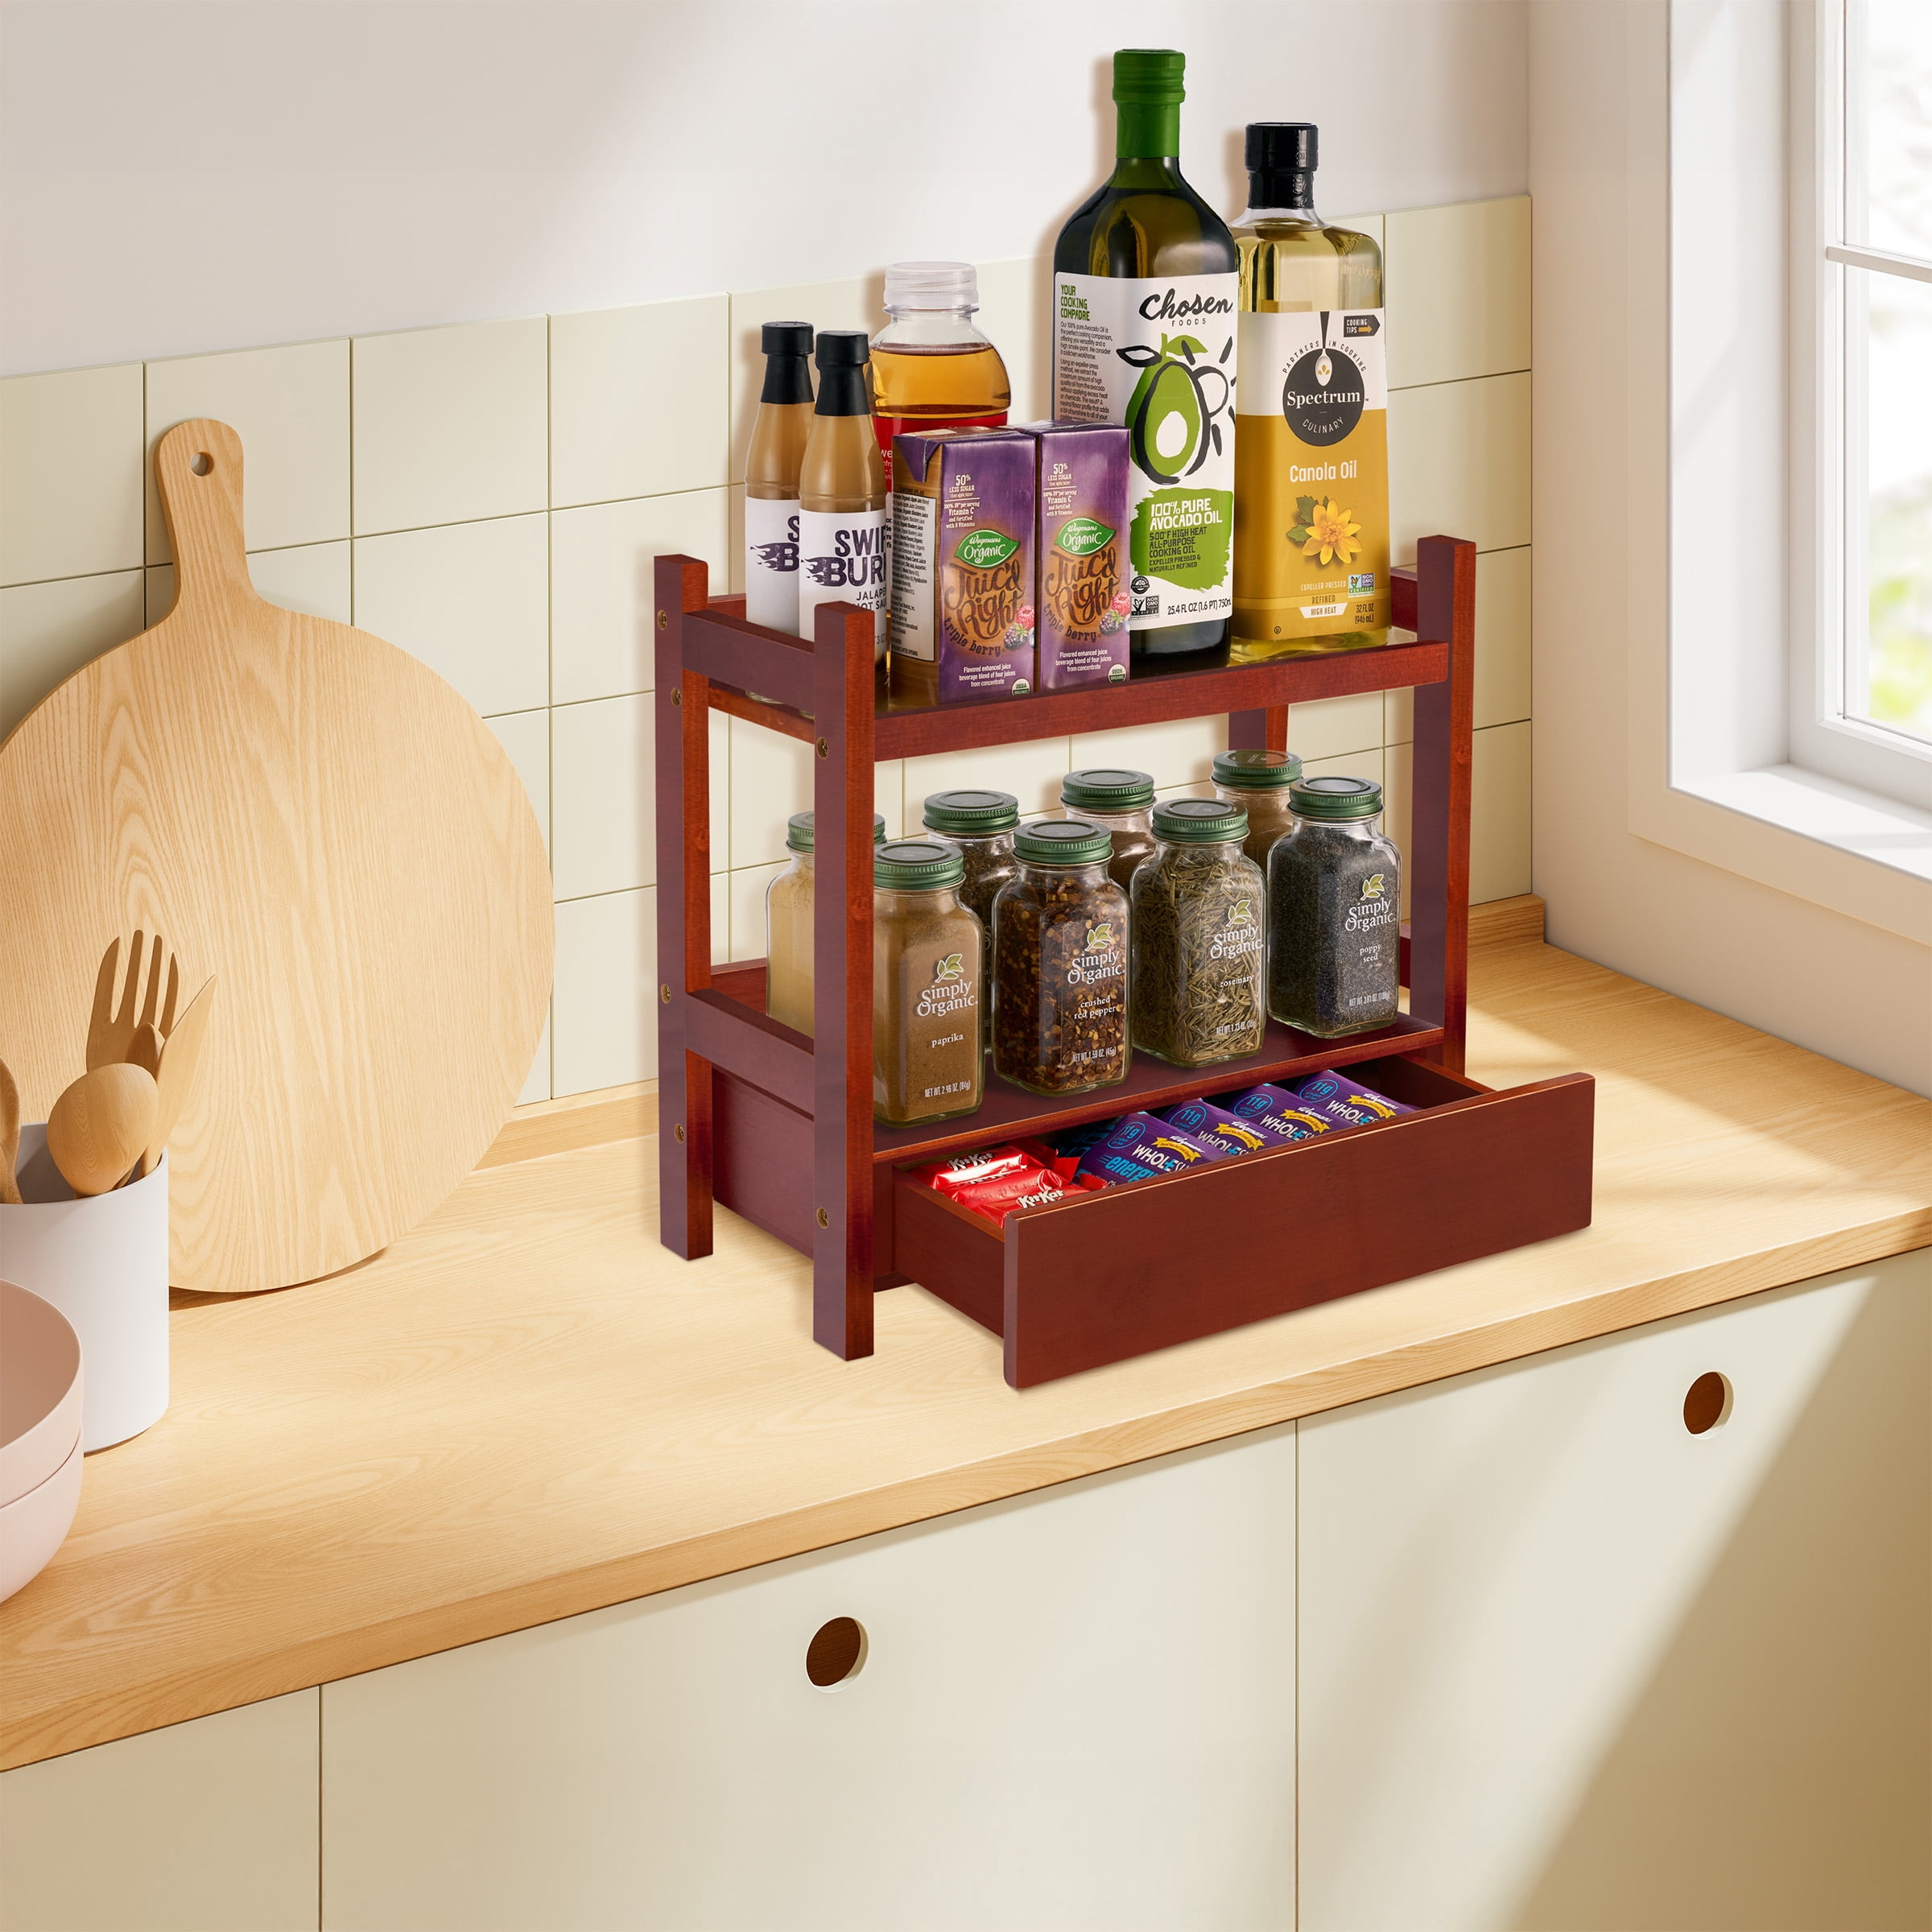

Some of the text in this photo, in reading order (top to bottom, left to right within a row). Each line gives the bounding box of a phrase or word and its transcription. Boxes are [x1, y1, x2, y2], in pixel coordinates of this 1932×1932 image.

[1060, 284, 1076, 296] YOUR
[1060, 296, 1088, 309] COOKING
[1138, 288, 1233, 321] Chosen
[1060, 308, 1090, 321] COMPADRE
[1171, 318, 1207, 327] FOODS
[1346, 318, 1368, 327] COOKING
[1346, 326, 1357, 334] TIPS
[1282, 341, 1319, 374] PARTNERS
[1340, 344, 1367, 373] COOKING
[1287, 390, 1361, 410] Spectrum
[1302, 416, 1344, 434] CULINARY
[1053, 463, 1068, 475] 50%
[1290, 460, 1357, 482] Canola Oil
[956, 473, 971, 486] 50%
[948, 508, 969, 516] Vitamin
[1150, 497, 1212, 518] 100% PURE
[1150, 510, 1223, 531] AVOCADO OIL
[1067, 522, 1097, 535] Wegmans
[1172, 528, 1189, 539] HIGH
[1190, 526, 1208, 536] HEAT
[969, 535, 1001, 547] Wegmans
[1063, 532, 1102, 551] Organic
[1150, 537, 1195, 550] ALL-PURPOSE
[964, 544, 1005, 564] Organic
[1150, 546, 1195, 558] COOKING OIL
[1149, 564, 1175, 572] NATURALLY
[1150, 557, 1174, 566] EXPELLER
[800, 552, 886, 587] BUR
[1301, 580, 1347, 592] EXPELLER PRESSED
[1055, 574, 1121, 625] Right
[1311, 595, 1335, 604] REFINED
[957, 586, 1026, 640] Right
[1167, 605, 1180, 615] 25.4
[1181, 604, 1187, 613] FL
[1188, 602, 1198, 612] OZ
[1311, 606, 1336, 616] HIGH HEAT
[1356, 603, 1374, 613] 32 FL OZ
[1043, 603, 1096, 642] triple berry
[943, 617, 1001, 657] triple berry
[1100, 655, 1112, 663] juices
[1348, 897, 1393, 919] Simply
[1214, 923, 1260, 946] Simply
[1360, 943, 1381, 956] poppy
[1071, 949, 1120, 970] Simply
[1363, 954, 1379, 964] seed
[1220, 974, 1255, 988] rosemary
[921, 980, 972, 1003] Simply
[1080, 995, 1111, 1009] crushed
[1074, 1005, 1116, 1020] red pepper
[931, 1033, 964, 1047] paprika
[1311, 1081, 1334, 1095] 11g
[1246, 1096, 1268, 1110] 11g
[1181, 1109, 1202, 1125] 11g
[1121, 1125, 1140, 1139] 11g
